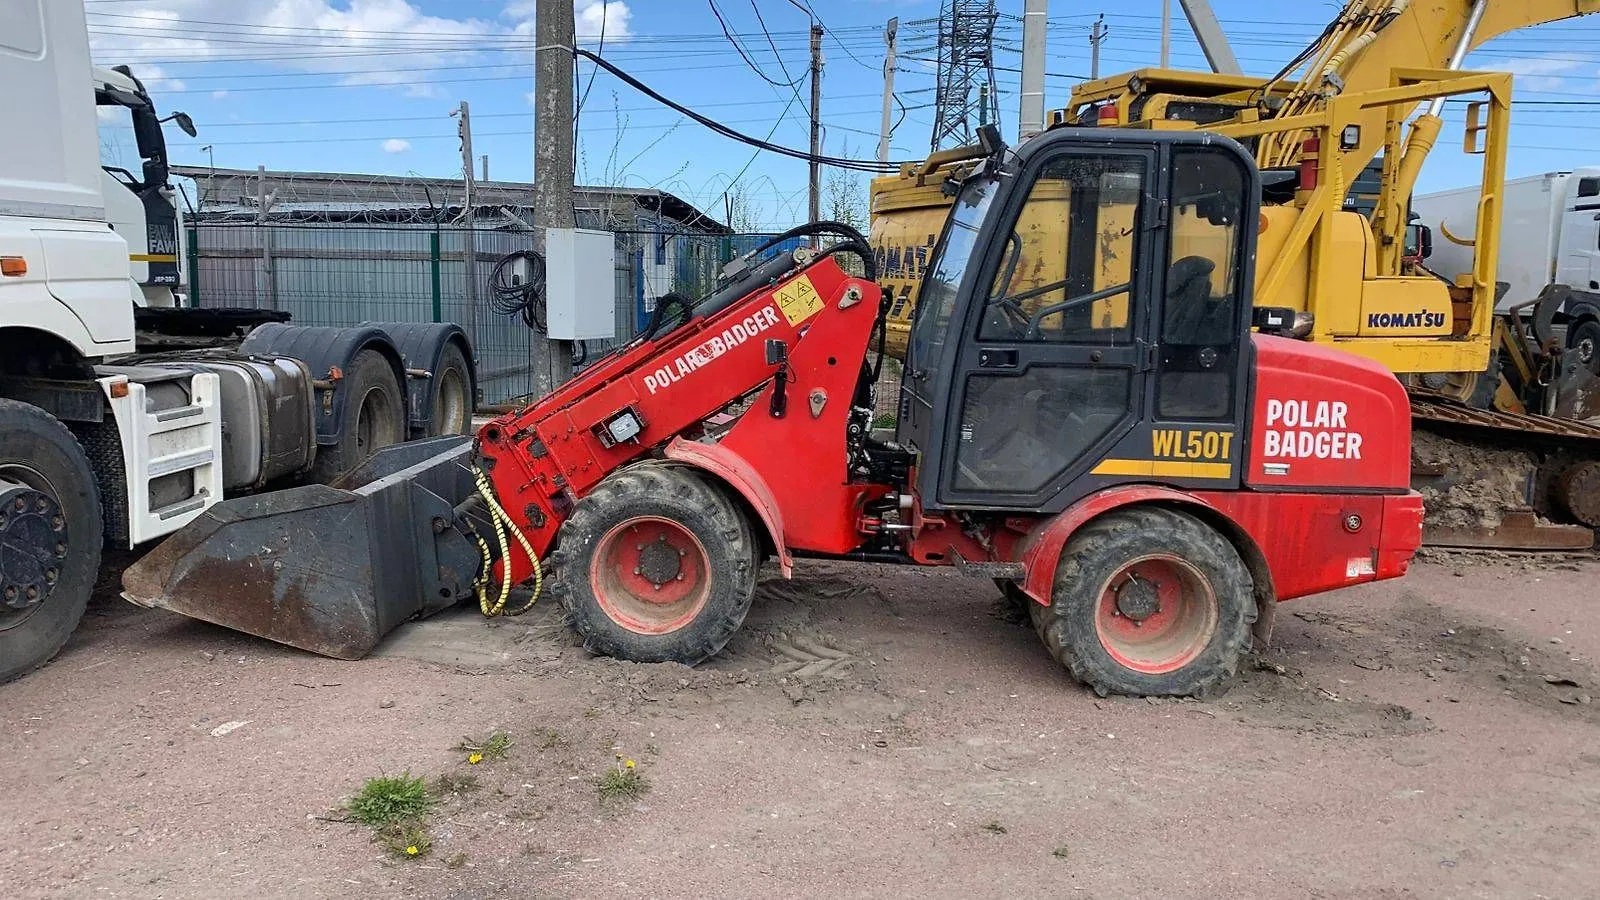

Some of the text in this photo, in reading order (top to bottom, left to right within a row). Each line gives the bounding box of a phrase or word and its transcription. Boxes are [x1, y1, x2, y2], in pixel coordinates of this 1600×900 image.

[149, 240, 175, 253] FAW
[643, 305, 781, 395] POLAR BADGER
[1265, 399, 1348, 429] POLAR
[1151, 429, 1234, 459] WL50T
[1263, 430, 1363, 460] BADGER
